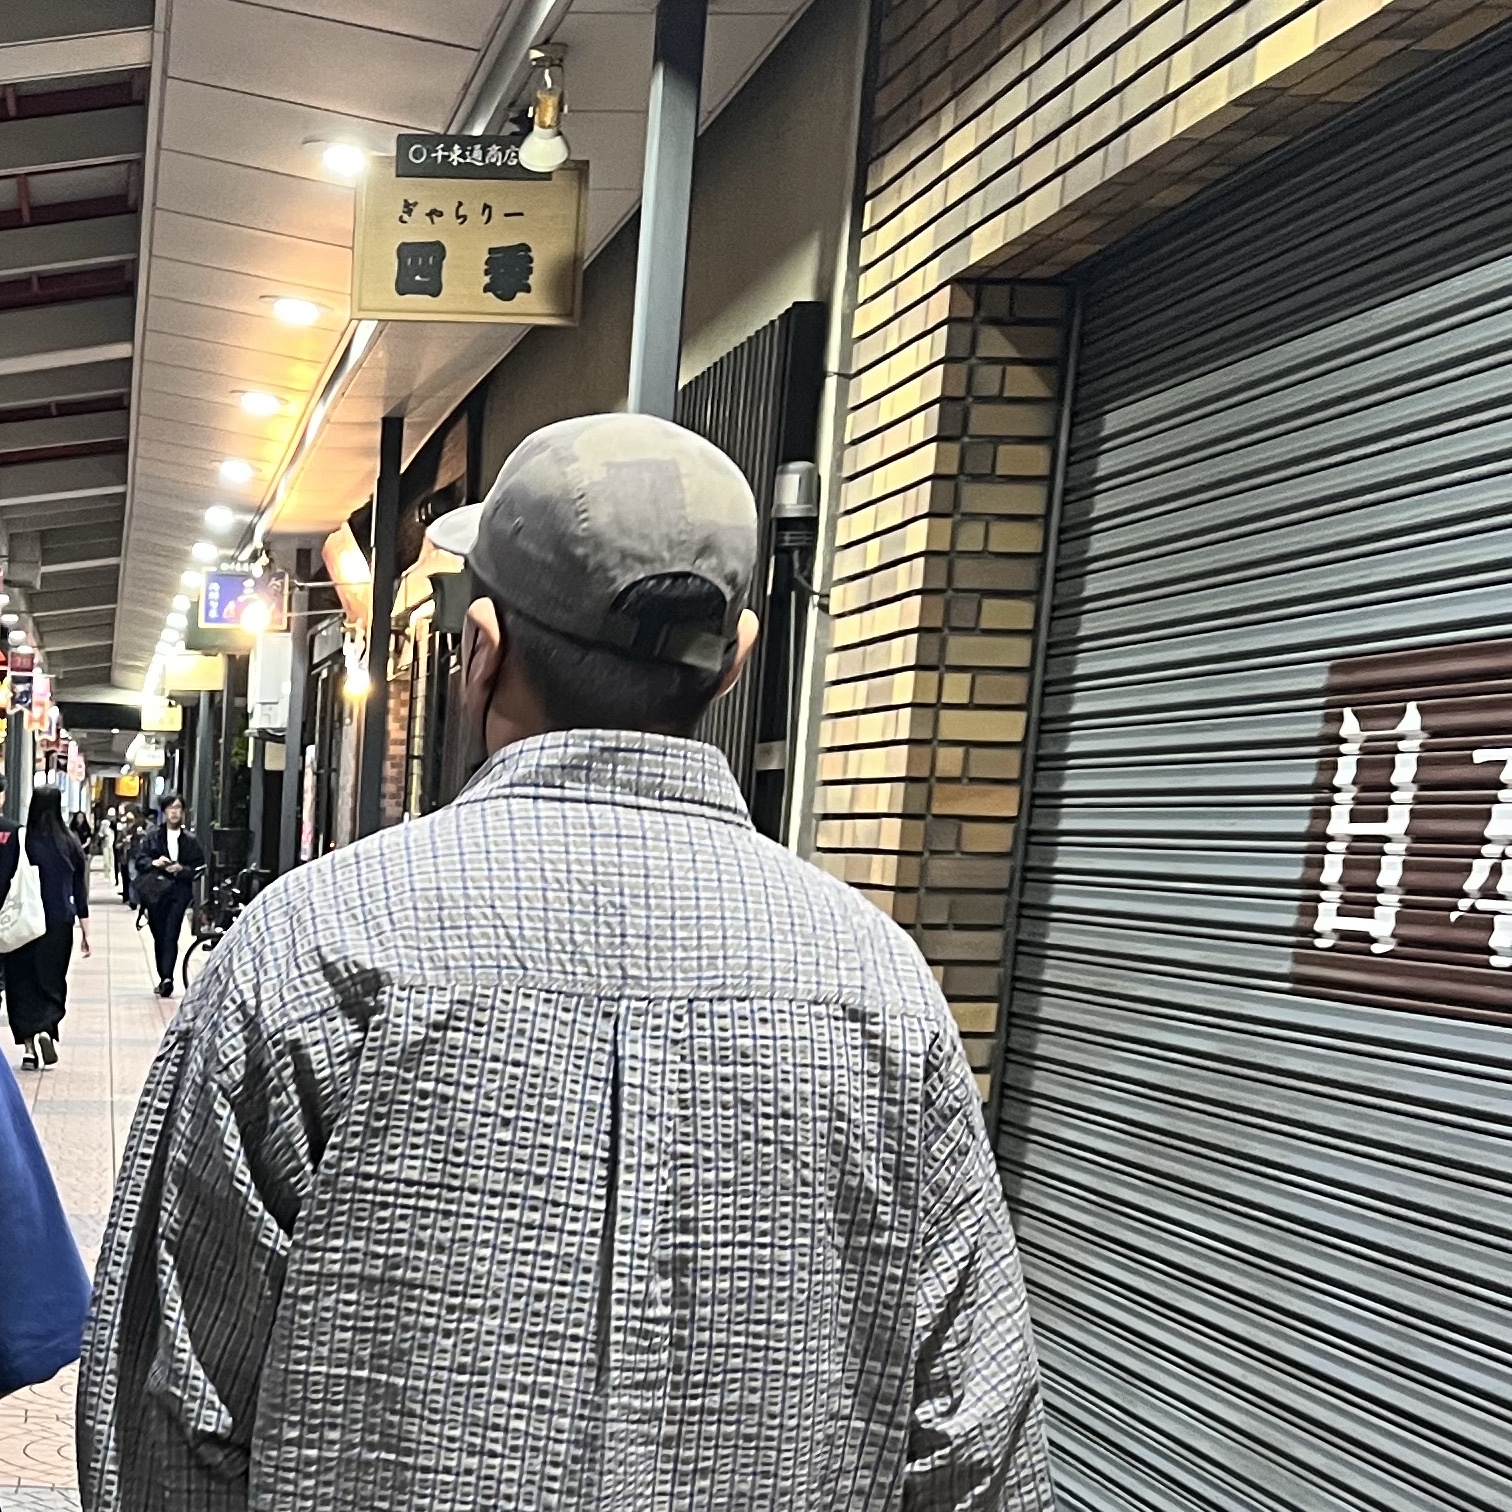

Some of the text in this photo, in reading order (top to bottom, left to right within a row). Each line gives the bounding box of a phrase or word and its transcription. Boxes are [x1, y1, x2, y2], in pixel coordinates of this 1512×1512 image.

[430, 143, 520, 166] 千束通商店
[398, 199, 524, 225] ぎゃらりー
